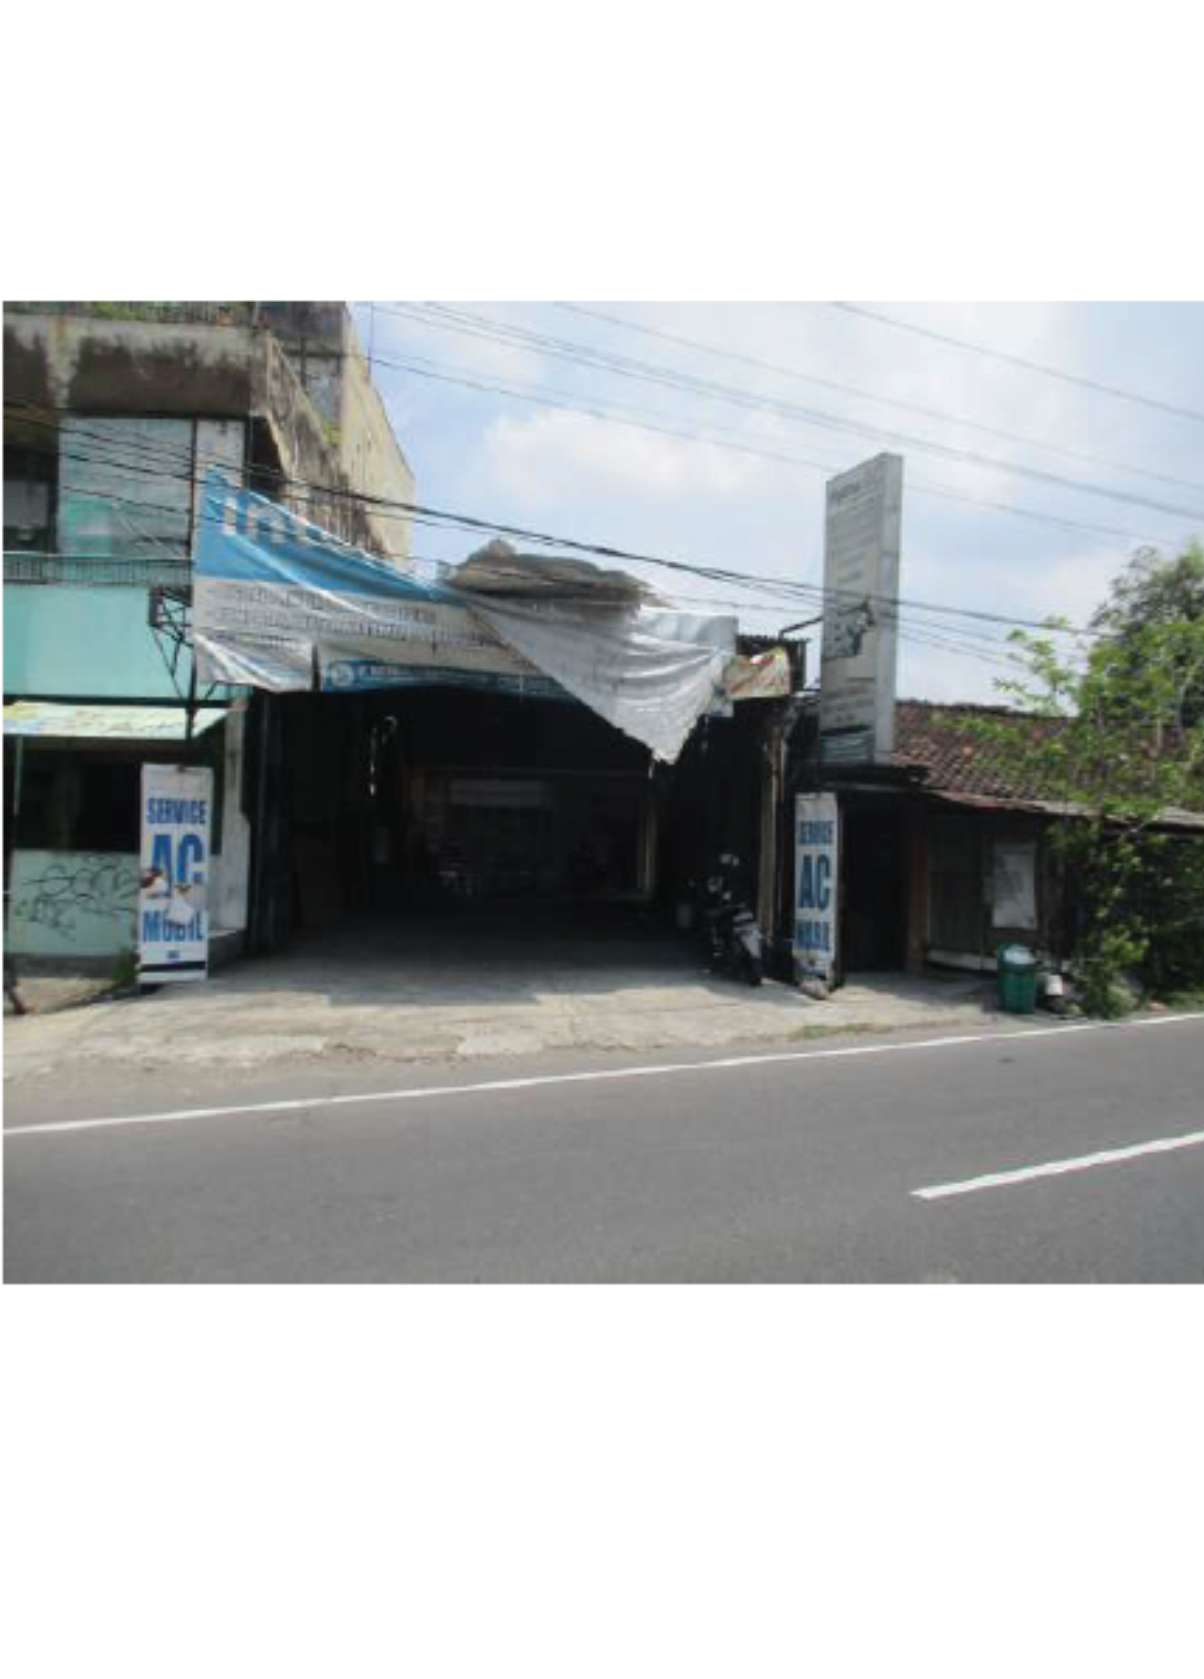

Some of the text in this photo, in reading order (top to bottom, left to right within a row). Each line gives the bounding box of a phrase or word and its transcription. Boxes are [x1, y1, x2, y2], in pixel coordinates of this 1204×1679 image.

[146, 798, 206, 825] SERVICE
[151, 834, 203, 897] AC
[799, 854, 830, 911] AC
